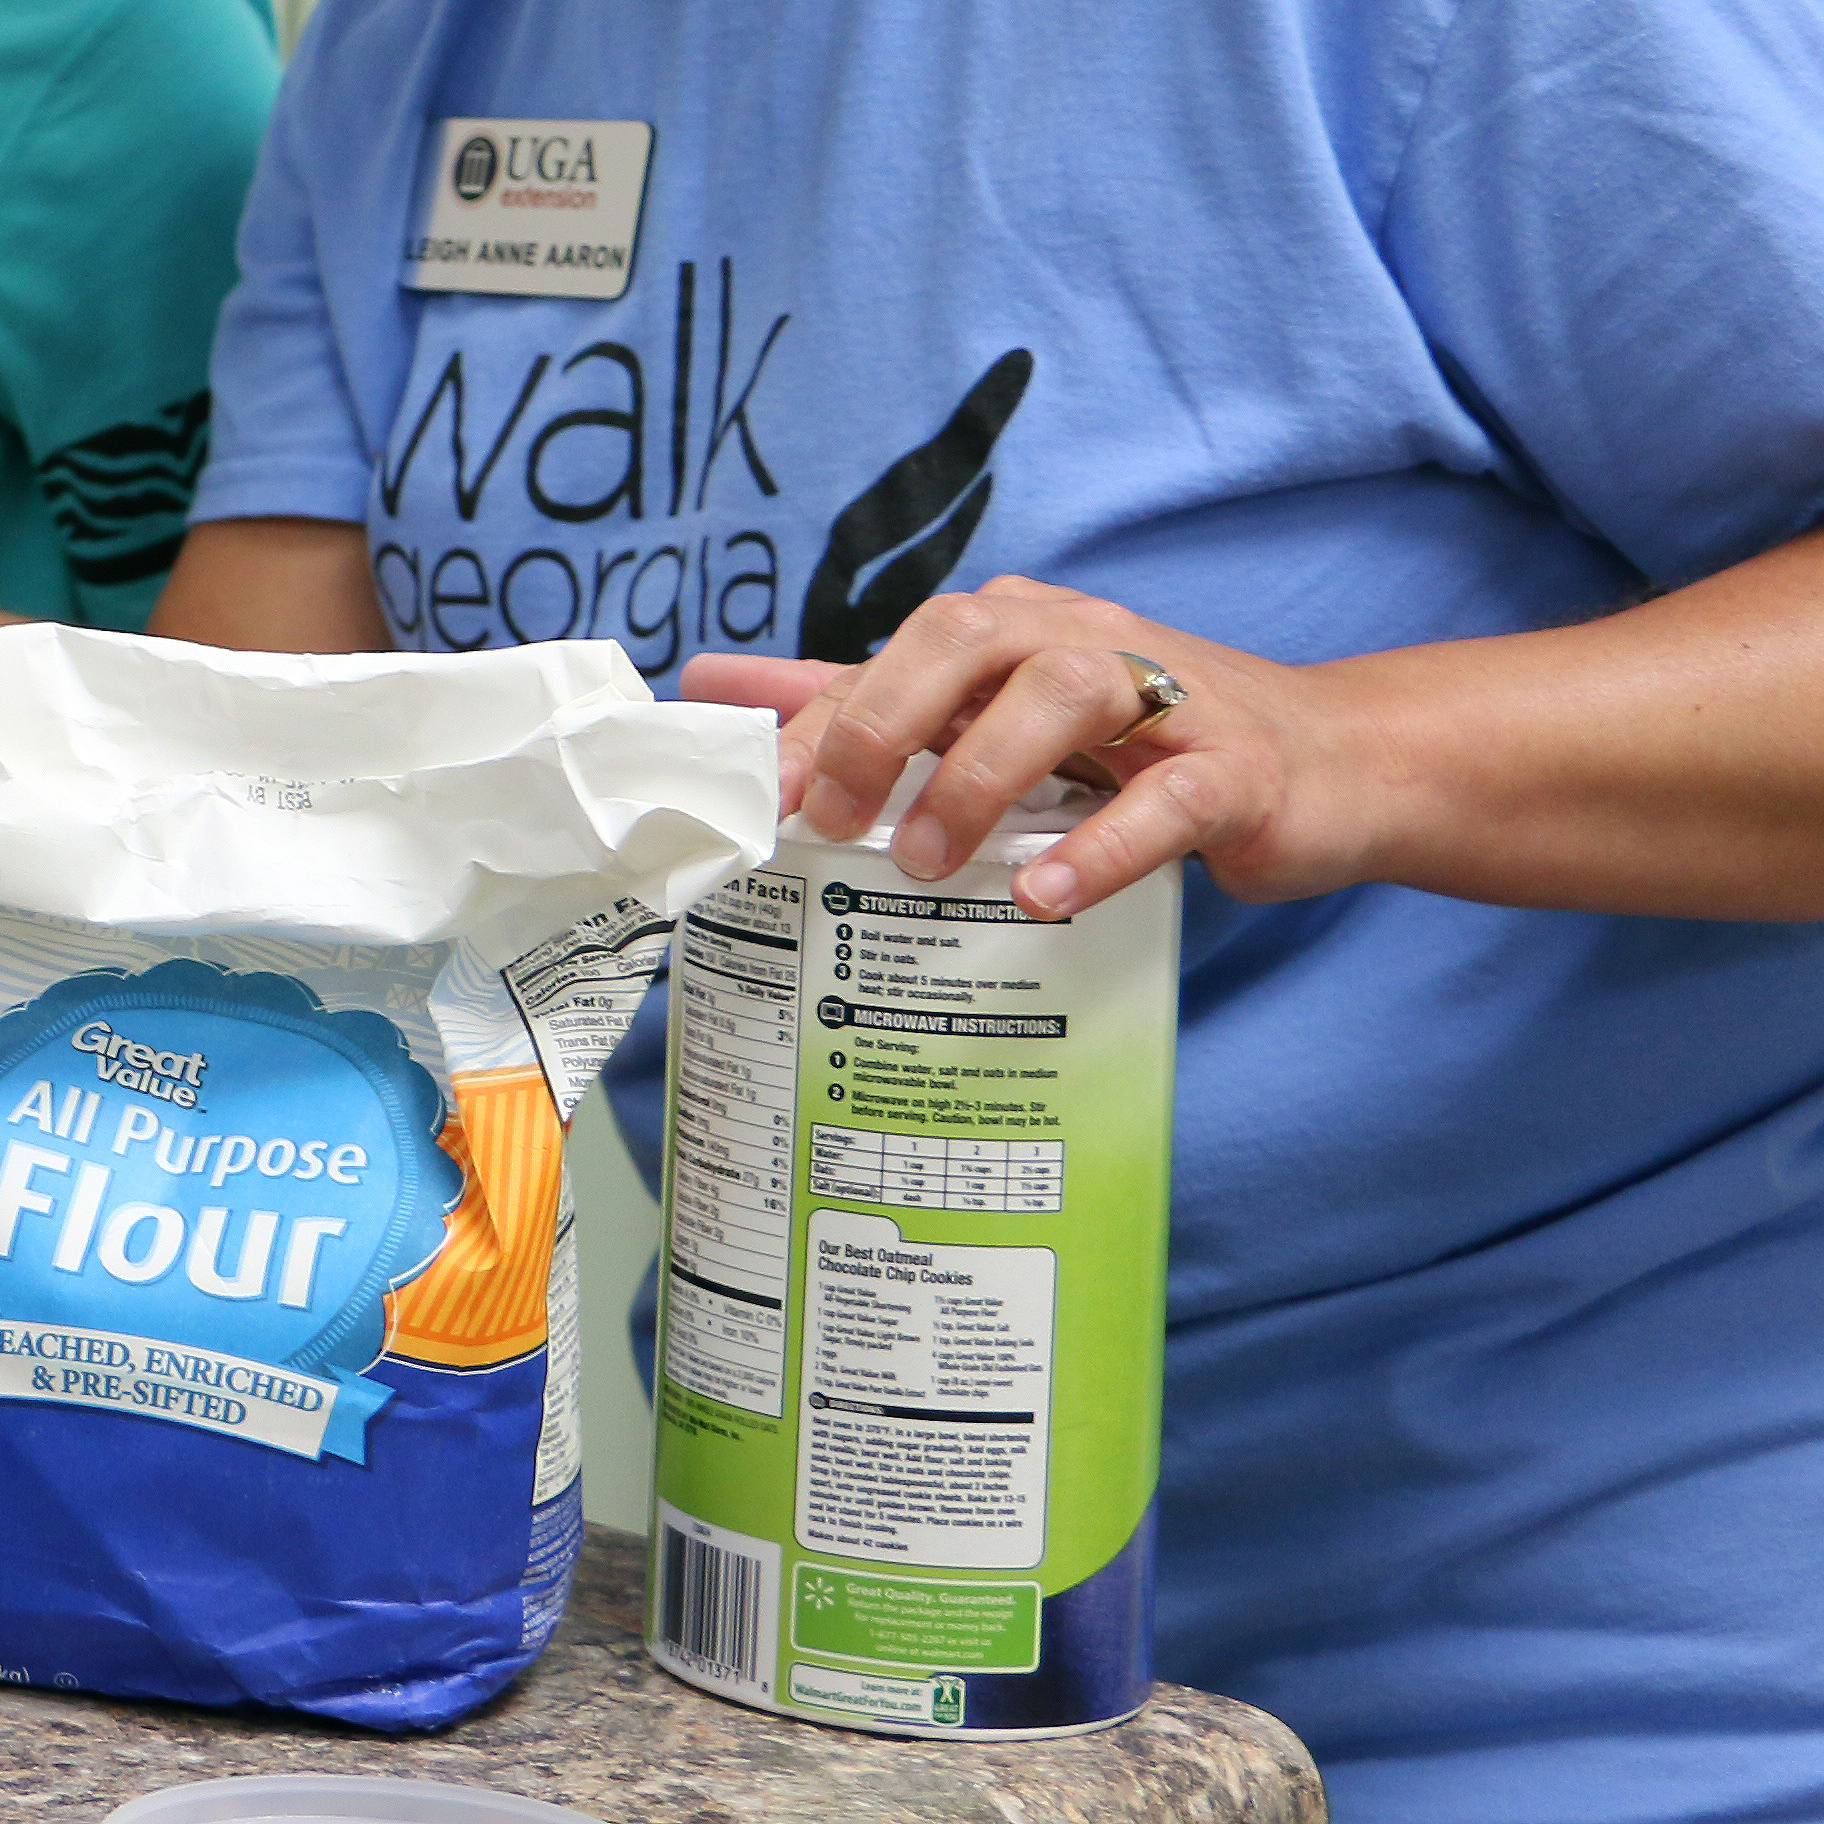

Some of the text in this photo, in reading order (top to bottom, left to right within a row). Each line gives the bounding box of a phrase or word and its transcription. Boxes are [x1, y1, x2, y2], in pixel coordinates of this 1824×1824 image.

[508, 136, 598, 182] UGA
[502, 188, 598, 209] extension
[406, 238, 629, 268] LEIGH ANNE AARON
[377, 256, 791, 521] walk
[372, 531, 780, 677] georgia
[747, 877, 800, 903] Facts
[859, 895, 936, 916] STOVETOP
[854, 1008, 1061, 1035] MICROWAVE INSTRUCTIONS:
[71, 1020, 209, 1089] Great
[94, 1055, 200, 1112] Value
[7, 1078, 369, 1189] All Purpose
[818, 1257, 973, 1285] Chocolate Chip Cookies
[819, 1239, 933, 1266] Our Best Oatmeal
[30, 1364, 248, 1428] & PRE-SIFTED
[144, 1348, 324, 1415] ENRICHED
